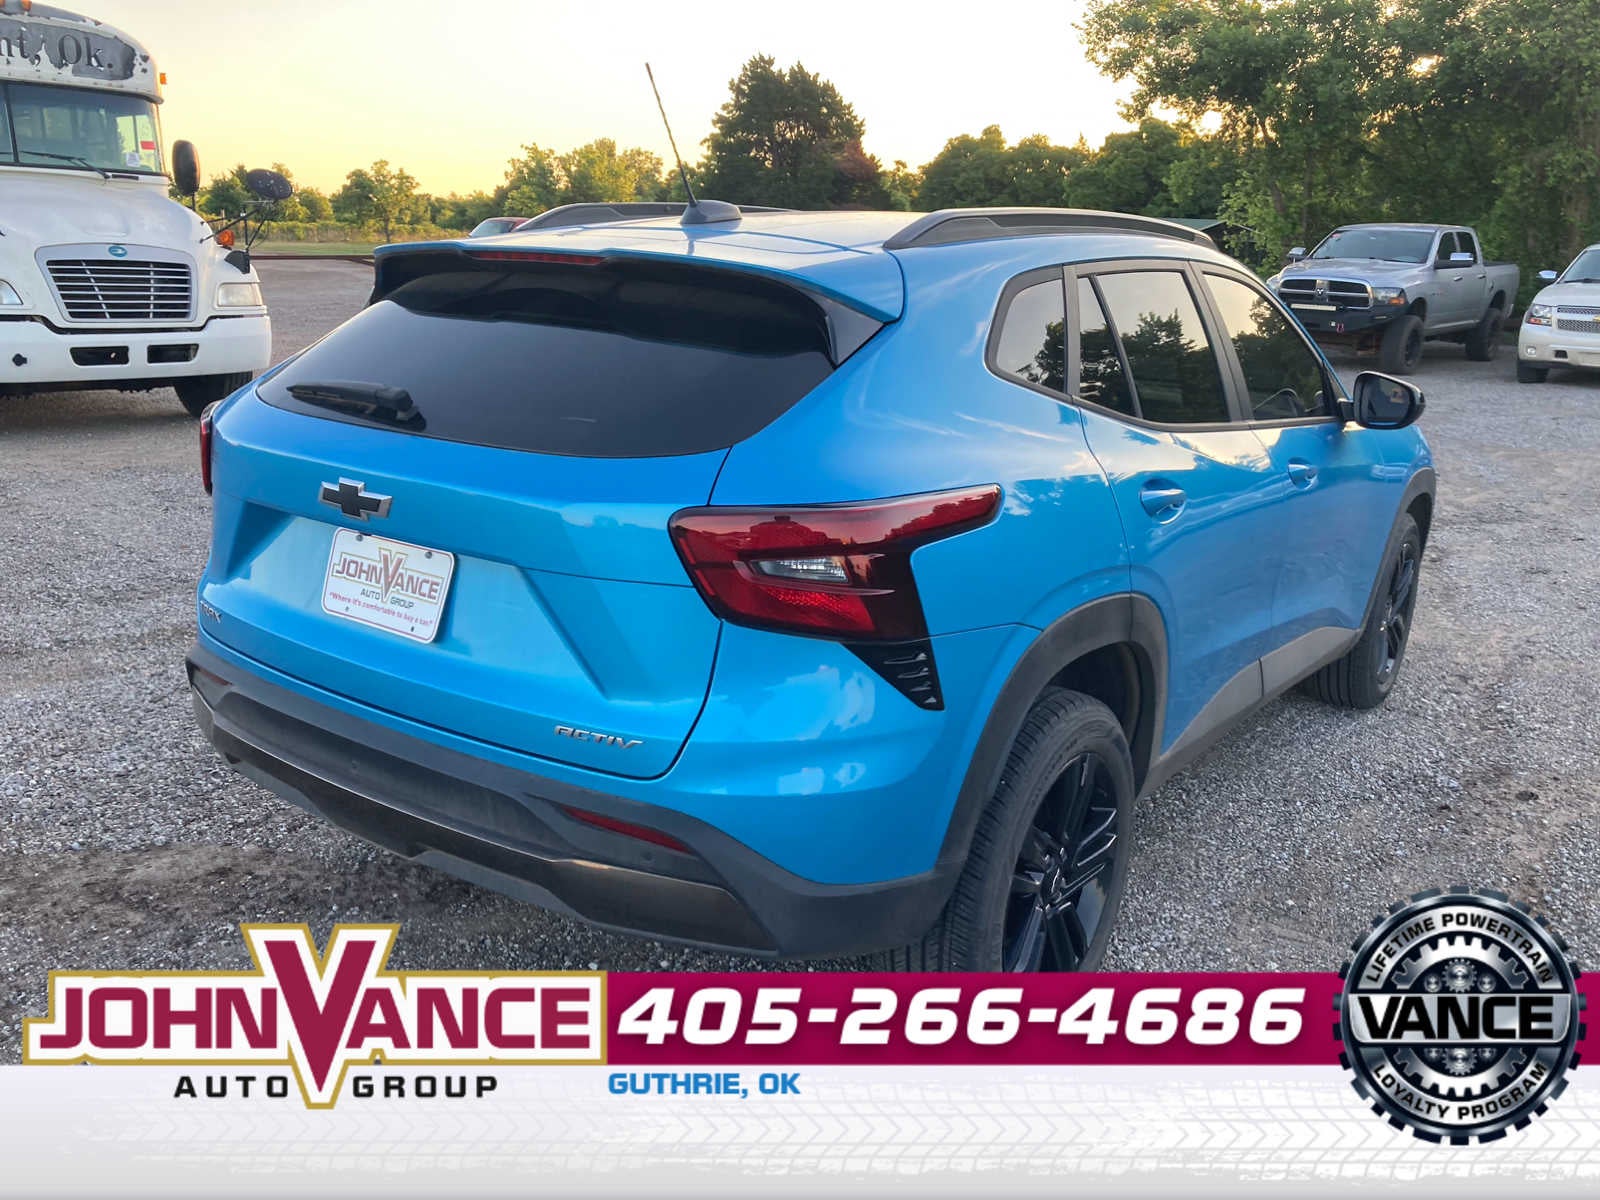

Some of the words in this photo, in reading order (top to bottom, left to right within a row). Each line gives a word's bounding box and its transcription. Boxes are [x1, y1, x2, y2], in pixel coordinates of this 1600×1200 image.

[58, 34, 114, 68] Ok.
[360, 588, 381, 600] AUTO
[390, 597, 414, 609] GROUP
[362, 601, 396, 617] comfortable
[396, 610, 403, 618] to
[403, 612, 414, 623] buy
[554, 724, 644, 750] ACTIV
